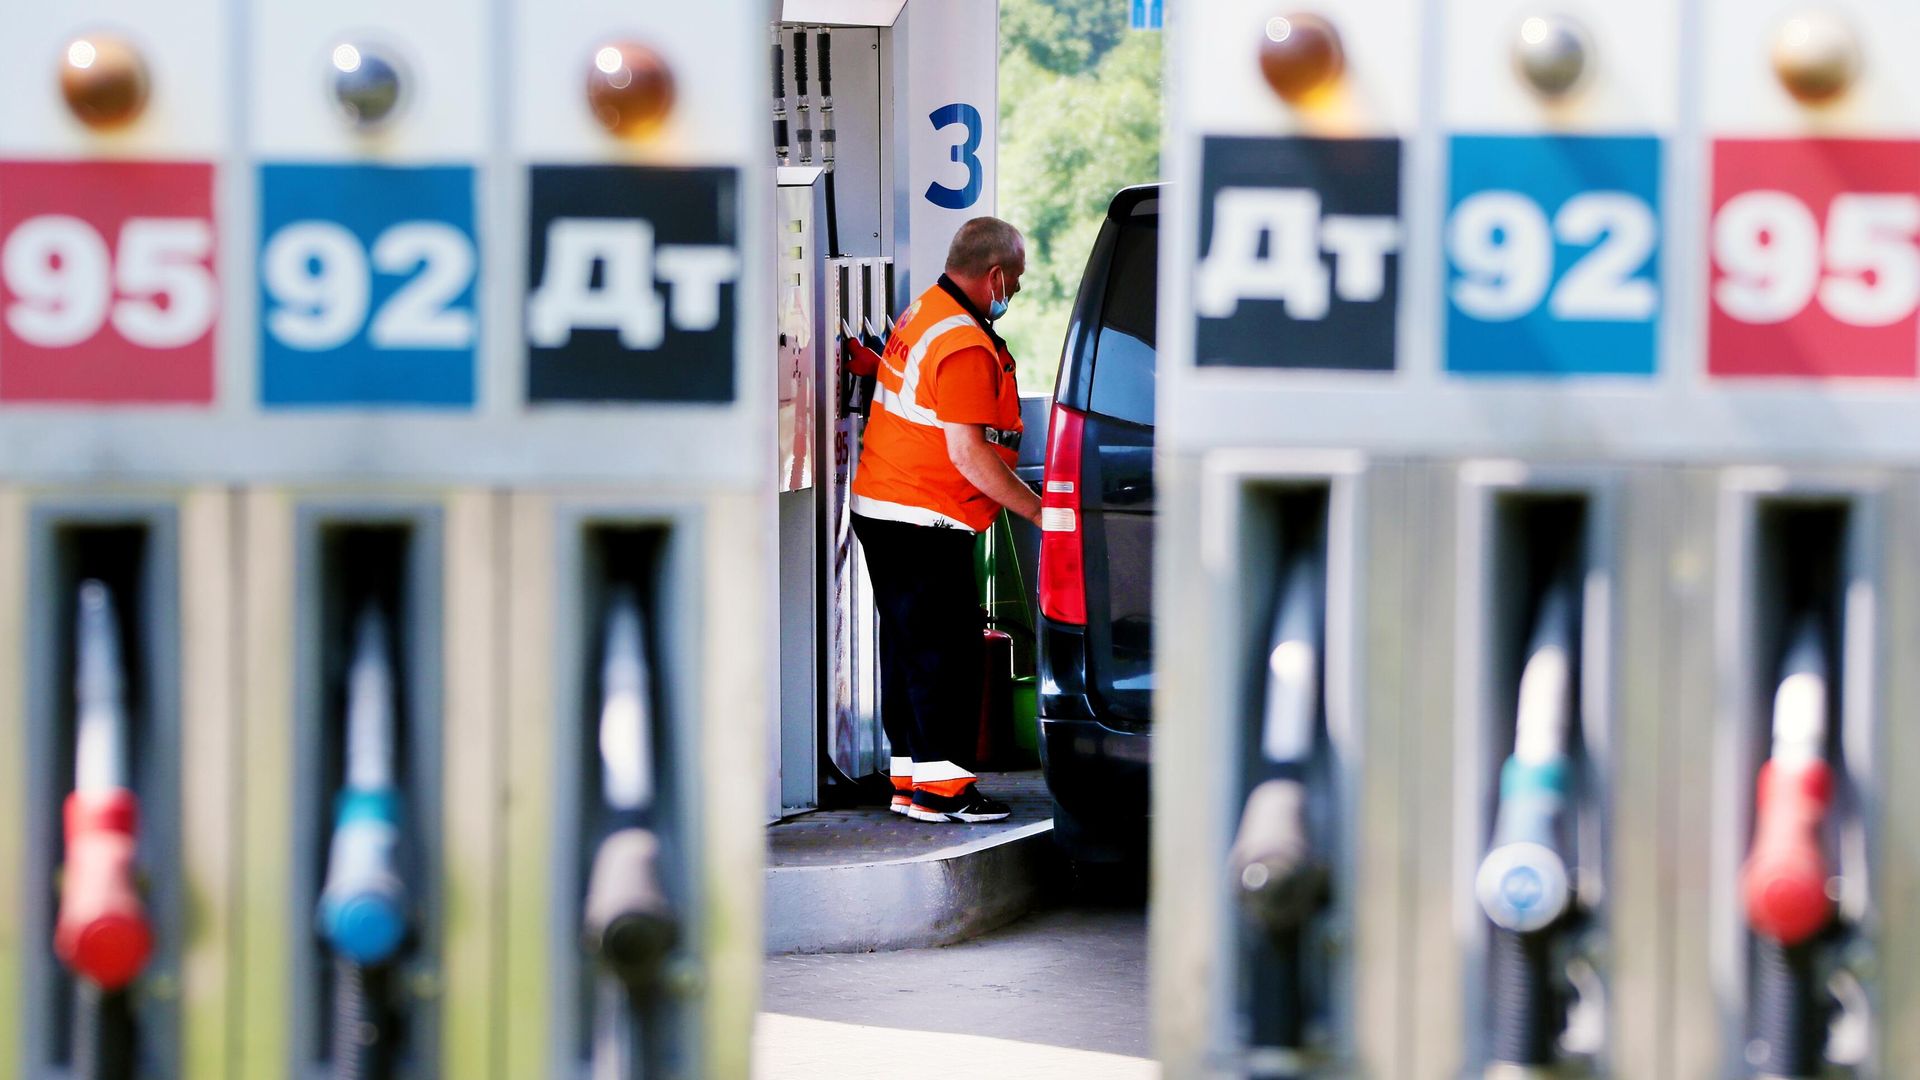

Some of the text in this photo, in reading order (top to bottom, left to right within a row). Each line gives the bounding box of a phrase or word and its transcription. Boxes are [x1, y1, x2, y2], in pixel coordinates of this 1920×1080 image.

[924, 103, 983, 210] 3
[1, 213, 218, 349] 95
[262, 218, 478, 351] 92
[527, 216, 741, 350] Дт
[1195, 186, 1403, 321] Дт
[1446, 189, 1659, 323] 92
[1711, 189, 1920, 327] 95
[836, 431, 848, 465] 95
